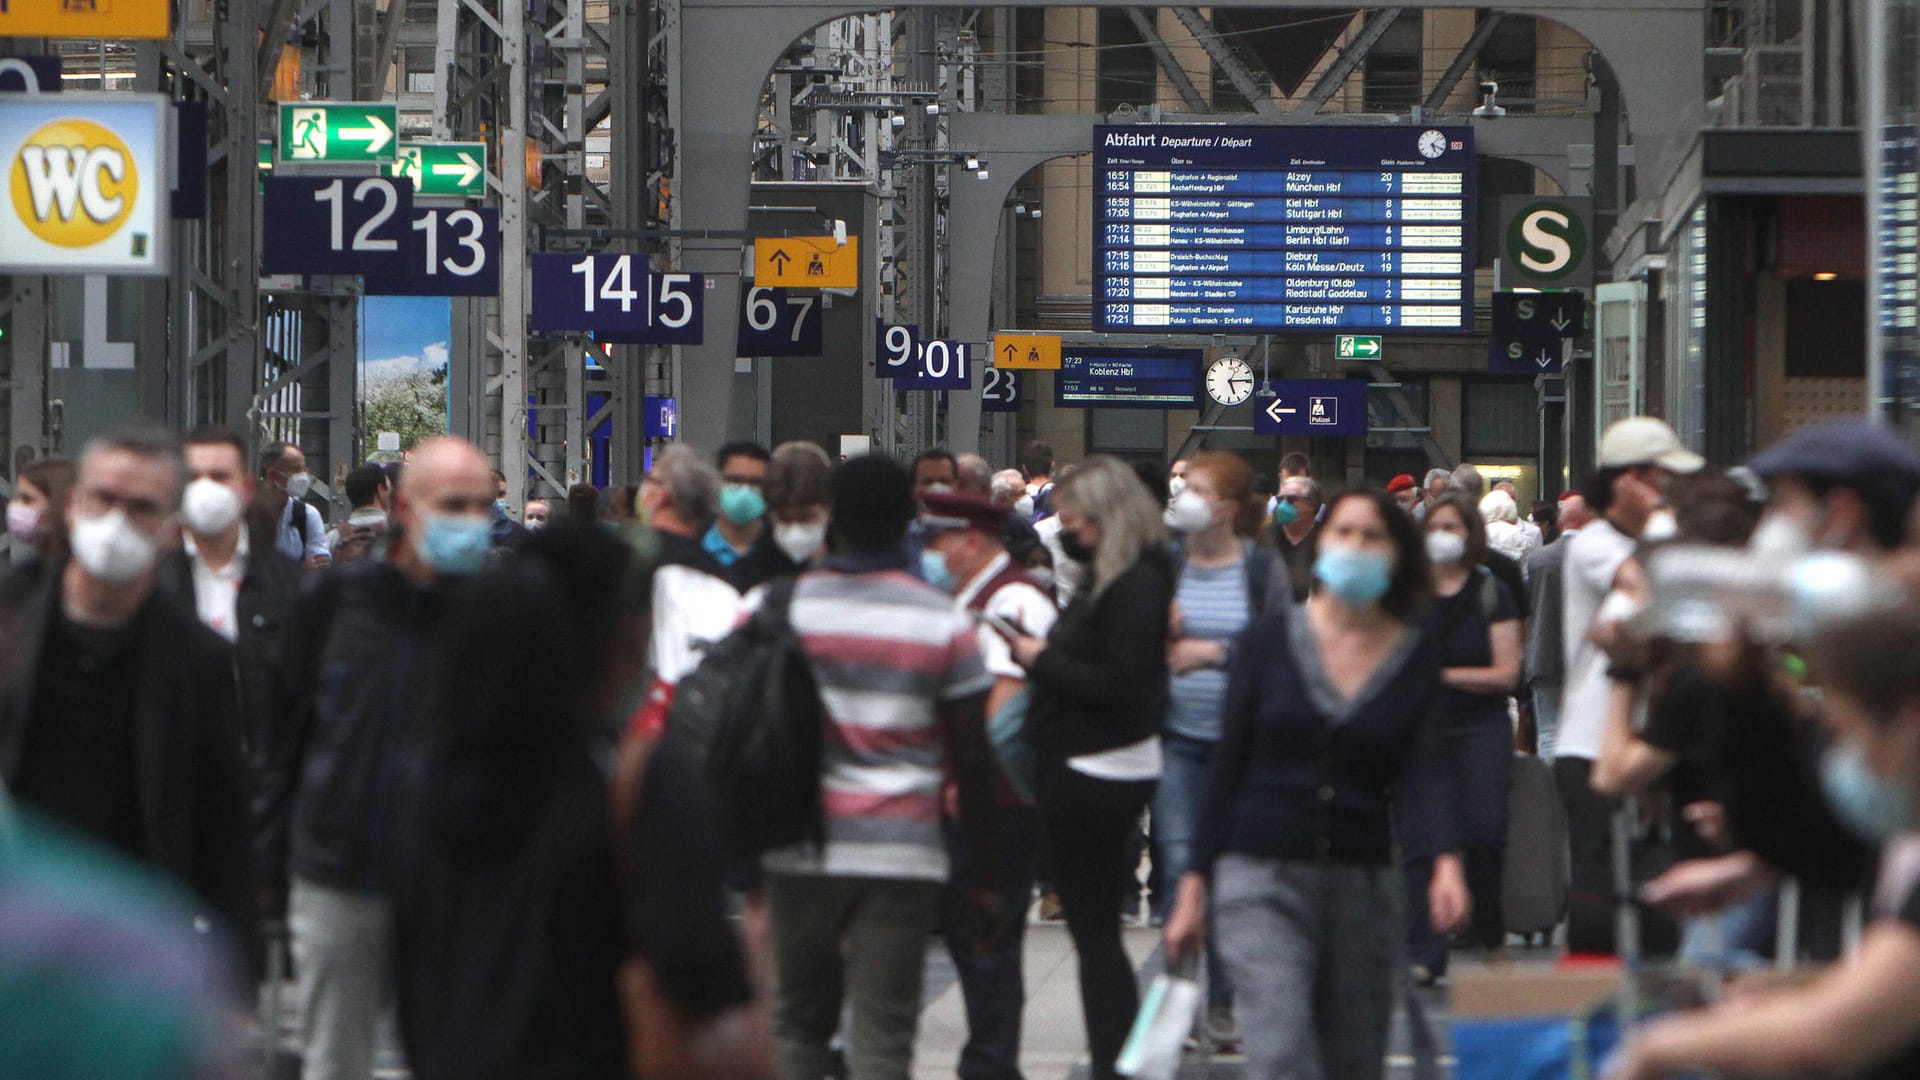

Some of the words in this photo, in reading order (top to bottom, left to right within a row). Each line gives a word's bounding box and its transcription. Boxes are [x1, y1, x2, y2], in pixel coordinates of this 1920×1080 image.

[1105, 133, 1156, 146] Abfahrt
[1161, 137, 1212, 148] Departure
[1221, 137, 1252, 148] Départ
[1287, 173, 1311, 182] Alzey
[1381, 173, 1392, 181] 20
[22, 145, 124, 224] WC
[1107, 182, 1129, 190] 16:54
[1287, 182, 1324, 192] München
[1327, 183, 1341, 192] Hbf
[1387, 184, 1392, 192] 7
[1287, 199, 1301, 207] Kiel
[1305, 199, 1319, 207] Hbf
[1386, 200, 1392, 208] 8
[314, 178, 398, 251] 12
[1107, 209, 1129, 217] 17:06
[1287, 209, 1325, 220] Stuttgart
[1328, 210, 1342, 218] Hbf
[1386, 210, 1392, 218] 6
[1106, 225, 1129, 233] 17:12
[412, 209, 486, 277] 13
[1106, 236, 1129, 244] 17:14
[1287, 236, 1310, 244] Berlin
[1313, 236, 1327, 244] Hbf
[1330, 236, 1349, 245] (tief)
[1386, 237, 1392, 245] 8
[1520, 209, 1572, 273] S
[1286, 252, 1318, 262] Dieburg
[1106, 262, 1129, 270] 17:16
[1286, 263, 1305, 271] Köln
[1307, 263, 1364, 272] Messe/Deutz
[571, 255, 638, 312] 14
[1106, 278, 1129, 286] 17:16
[1287, 279, 1328, 289] Oldenburg
[1331, 279, 1355, 288] (Oldb)
[1106, 289, 1129, 297] 17:20
[1287, 290, 1326, 298] Riedstadt
[1329, 290, 1367, 298] Goddelau
[746, 287, 777, 331] 6
[1286, 306, 1327, 314] Karlsruhe
[1329, 306, 1344, 314] Hbf
[1517, 300, 1535, 320] S
[786, 297, 814, 342] 7
[1106, 315, 1128, 323] 17:21
[1286, 316, 1321, 324] Dresden
[1323, 316, 1337, 325] Hbf
[1386, 317, 1391, 325] 9
[885, 326, 912, 366] 9
[1508, 342, 1523, 359] S
[1121, 368, 1133, 376] Hbf
